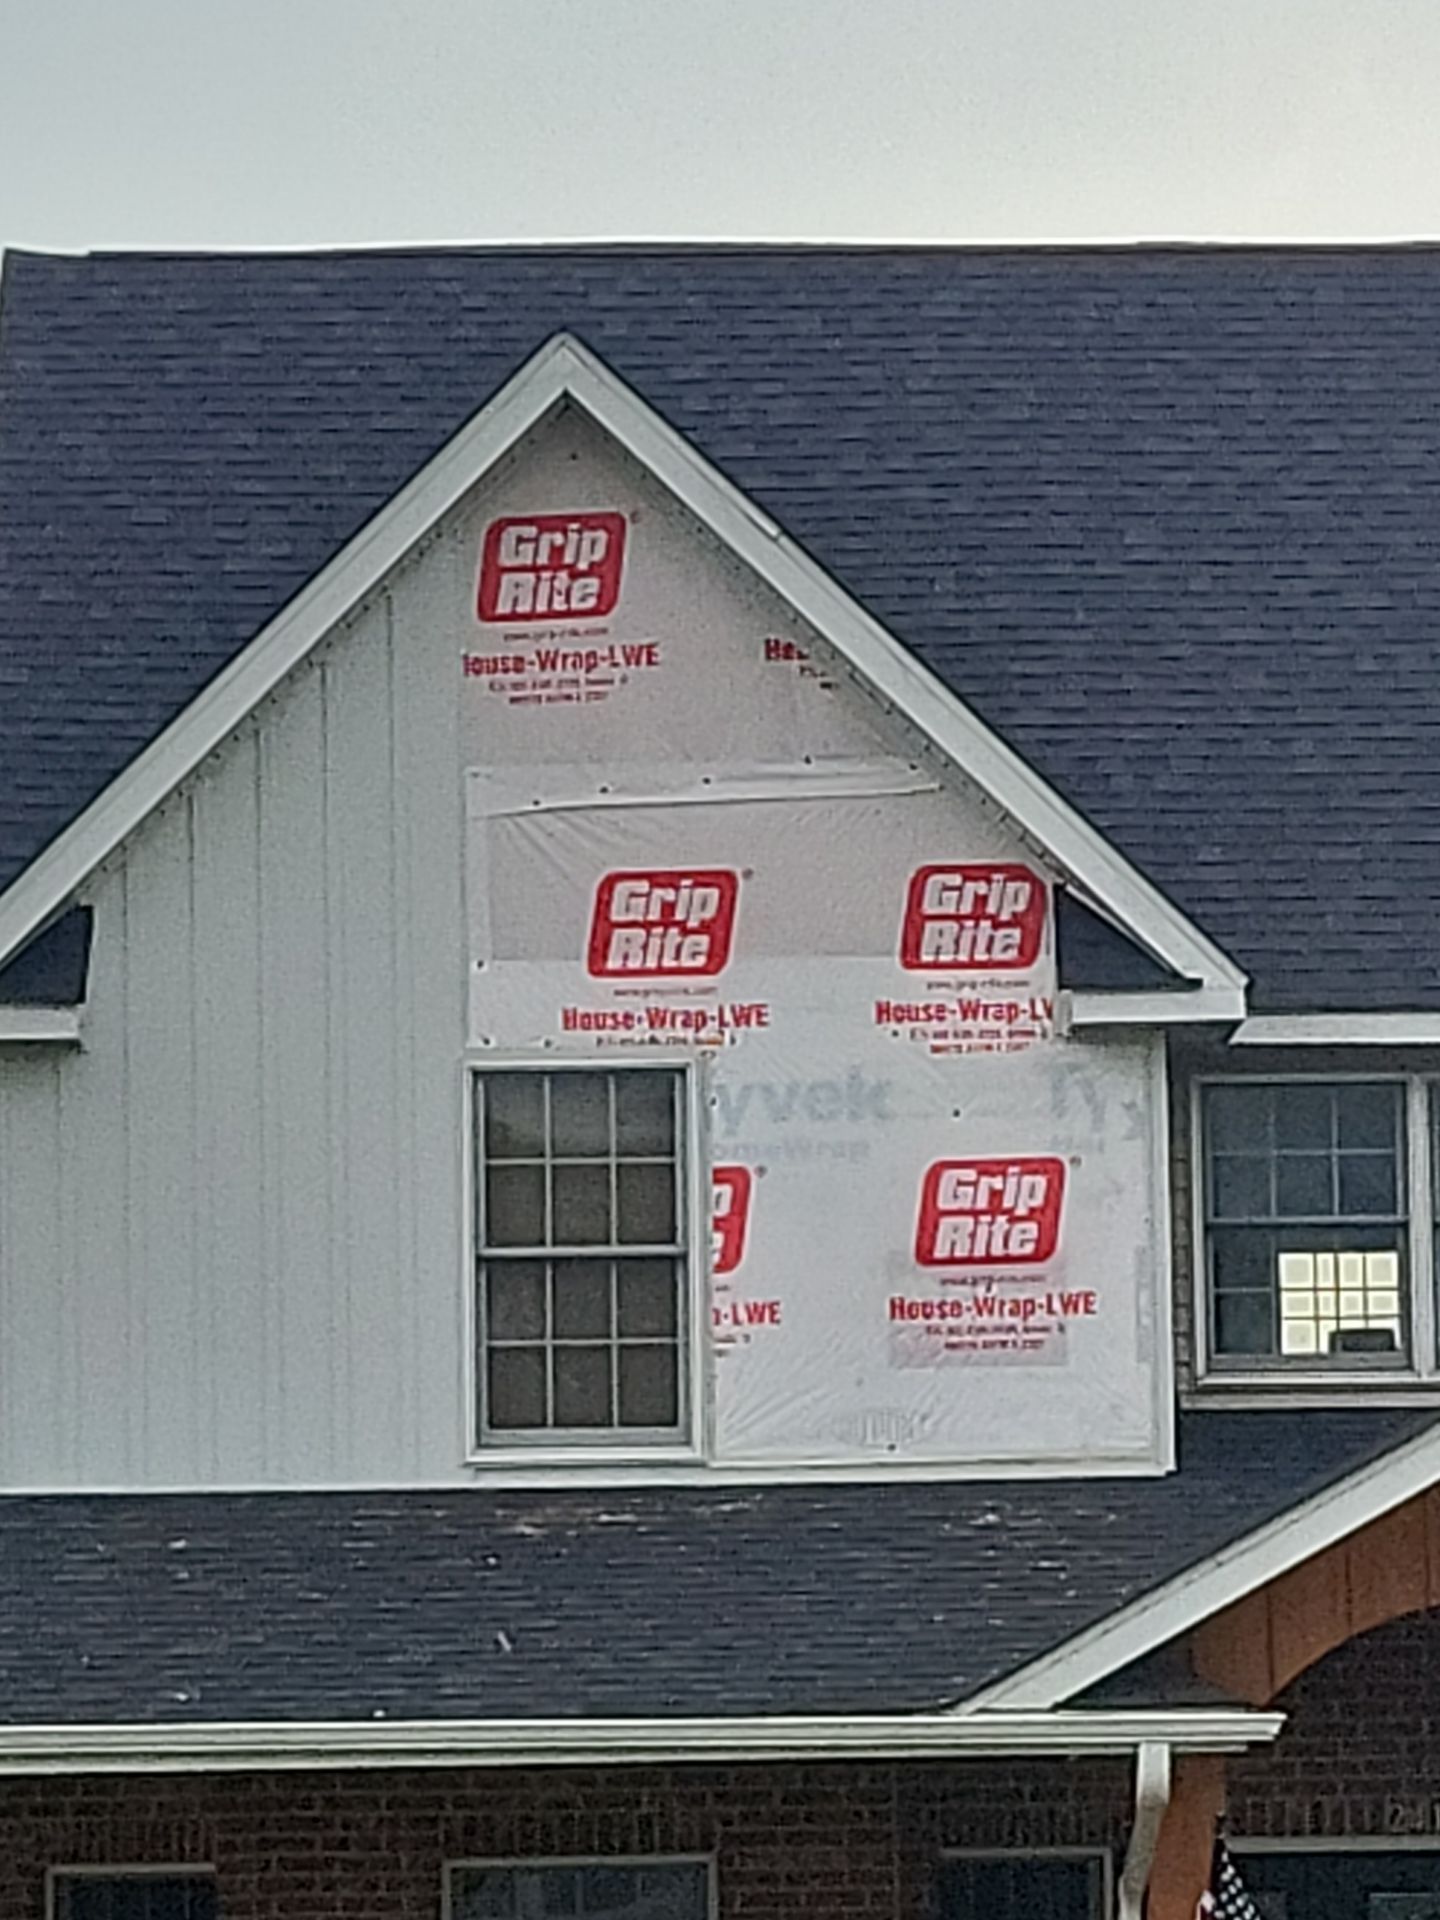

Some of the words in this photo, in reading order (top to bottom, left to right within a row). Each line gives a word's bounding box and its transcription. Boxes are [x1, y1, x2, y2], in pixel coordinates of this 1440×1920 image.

[498, 523, 609, 570] Grip
[495, 570, 601, 614] Rite
[609, 879, 720, 928] Grip
[922, 873, 1031, 920] Grip
[606, 926, 710, 970] Rite
[919, 919, 1022, 962] Rite
[561, 1003, 770, 1034] House-Wrap-LWE
[937, 1166, 1048, 1215] Grip
[933, 1215, 1039, 1259] Rite
[889, 1291, 1097, 1321] House-Wrap-LWE
